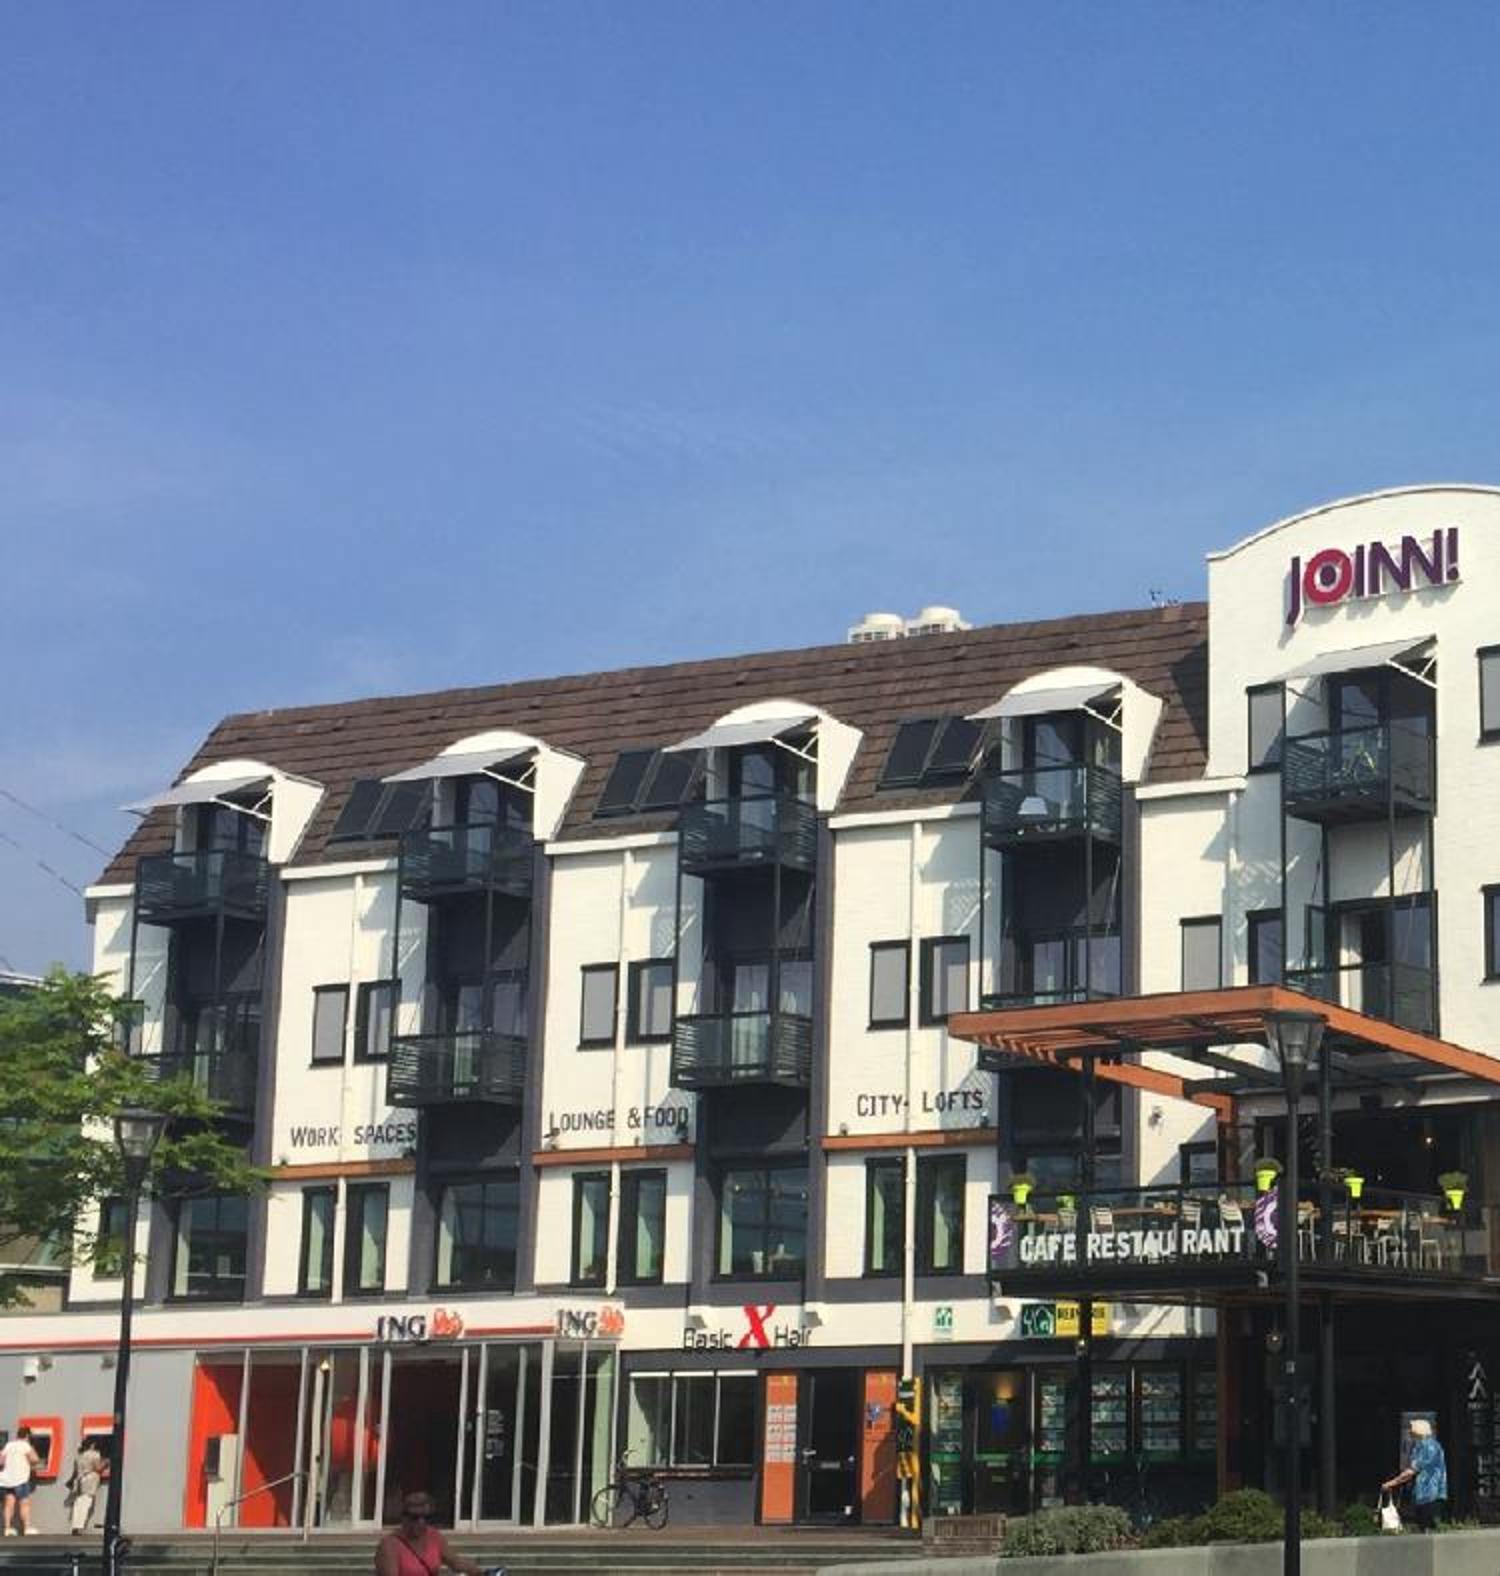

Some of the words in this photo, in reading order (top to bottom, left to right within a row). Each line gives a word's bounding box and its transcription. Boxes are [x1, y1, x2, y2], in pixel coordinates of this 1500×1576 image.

[1286, 528, 1459, 625] JOINN!
[921, 1089, 983, 1113] LOFTS
[352, 1122, 417, 1145] SPACES
[549, 1109, 615, 1135] LOUNGE
[643, 1105, 688, 1129] FOOD
[1019, 1233, 1077, 1263] CAFE
[377, 1315, 427, 1339] ING
[557, 1309, 598, 1337] ING
[683, 1326, 733, 1352] Basic
[736, 1302, 776, 1349] X
[774, 1324, 812, 1348] Hair
